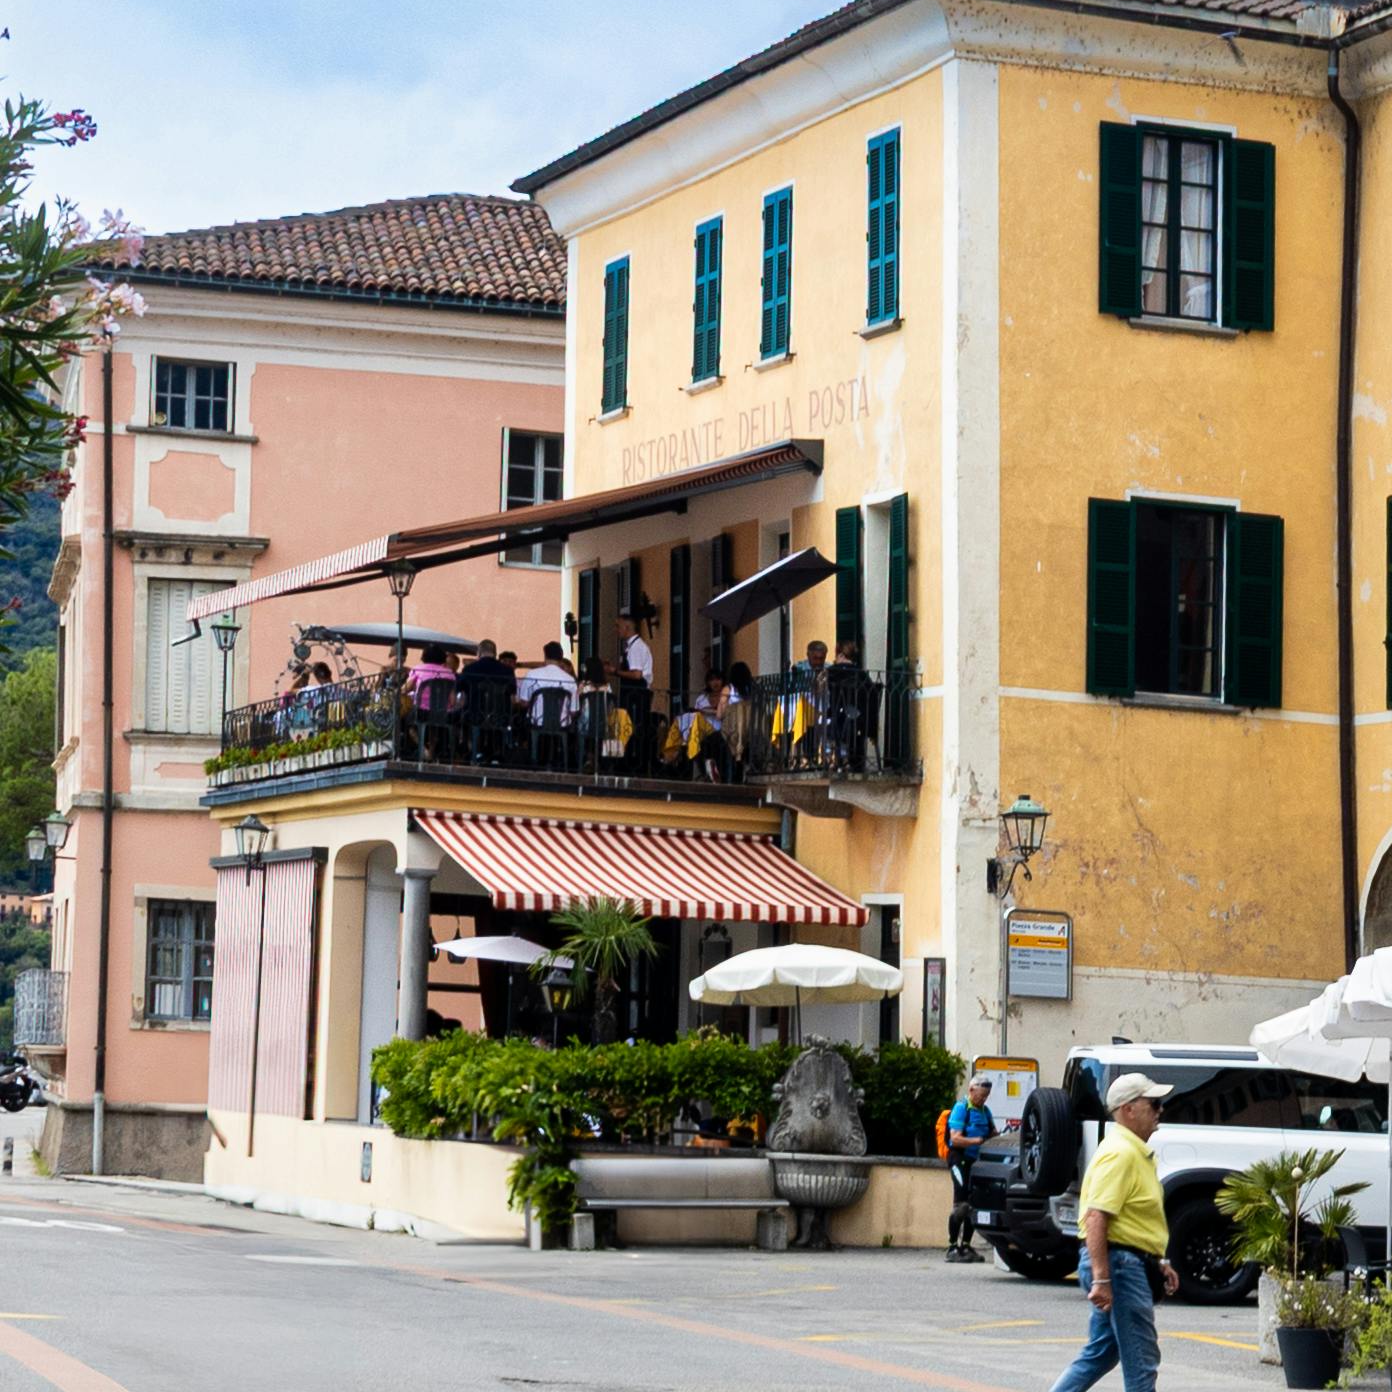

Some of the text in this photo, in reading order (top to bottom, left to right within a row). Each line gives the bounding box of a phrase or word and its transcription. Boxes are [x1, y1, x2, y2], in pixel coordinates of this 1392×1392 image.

[621, 375, 870, 486] RISTORANTE DELLA POSTA
